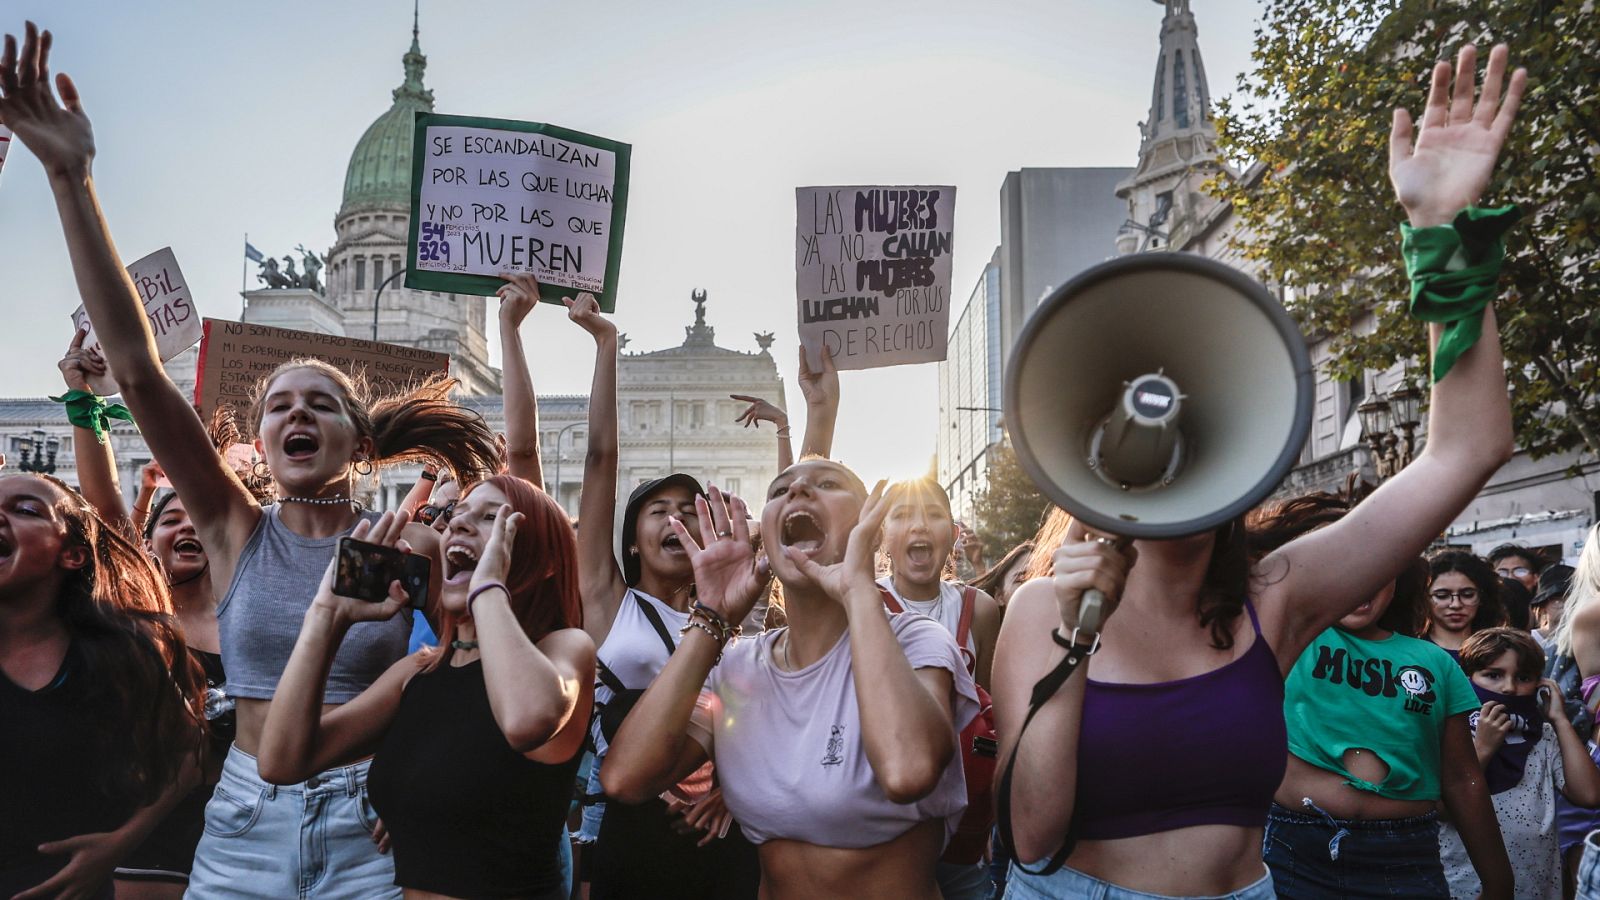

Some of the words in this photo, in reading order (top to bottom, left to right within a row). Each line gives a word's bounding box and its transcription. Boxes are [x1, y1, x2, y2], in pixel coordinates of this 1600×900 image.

[432, 136, 452, 156] SE
[464, 136, 599, 168] ESCANDALIZAN
[432, 167, 468, 186] POR
[479, 168, 510, 188] LAS
[521, 172, 559, 193] QUE
[565, 178, 613, 204] LUCHAN
[427, 203, 436, 220] Y
[441, 205, 463, 222] NO
[471, 203, 509, 223] POR
[521, 206, 554, 228] LAS
[567, 216, 603, 236] QUE
[814, 190, 844, 235] LAS
[854, 189, 940, 236] MUJERES
[421, 221, 446, 242] 54
[418, 240, 450, 264] 329
[463, 231, 582, 273] MUEREN
[801, 234, 821, 266] YA
[840, 233, 865, 263] NO
[882, 231, 952, 259] CALLAN
[821, 263, 846, 295] LAS
[856, 257, 936, 298] MUJERES
[802, 296, 880, 324] LUCHAN
[896, 289, 920, 317] POR
[923, 286, 943, 313] SUS
[223, 342, 236, 353] MI
[224, 323, 243, 335] NO
[249, 327, 272, 338] SON
[314, 334, 347, 347] PERO
[351, 338, 371, 350] SON
[376, 341, 392, 354] UN
[822, 319, 934, 358] DERECHOS
[220, 370, 256, 383] ESTÁN
[222, 358, 244, 369] LOS
[1404, 699, 1433, 716] LIVE
